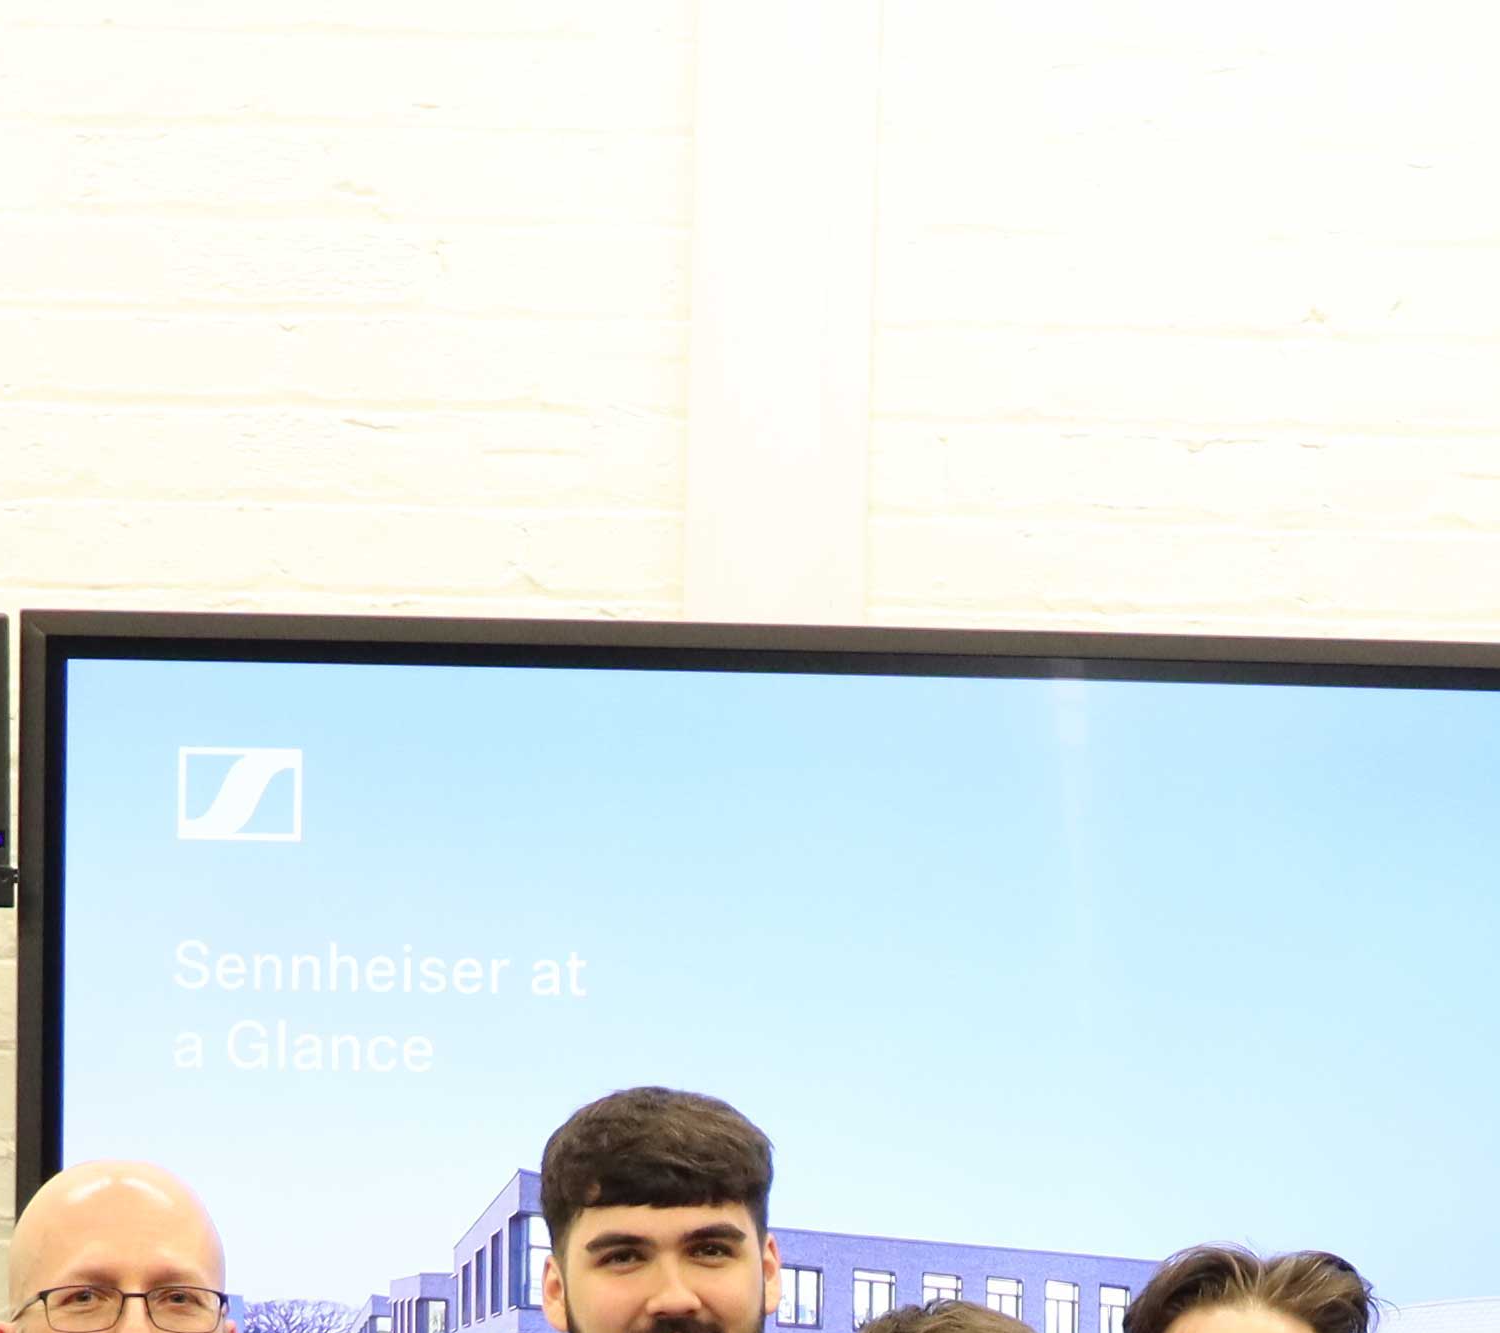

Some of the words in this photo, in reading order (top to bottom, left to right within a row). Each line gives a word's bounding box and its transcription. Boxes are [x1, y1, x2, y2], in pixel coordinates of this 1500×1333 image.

[172, 939, 510, 994] Sennheiser
[531, 951, 587, 998] at
[172, 1031, 204, 1070] a
[227, 1019, 435, 1073] Glance
